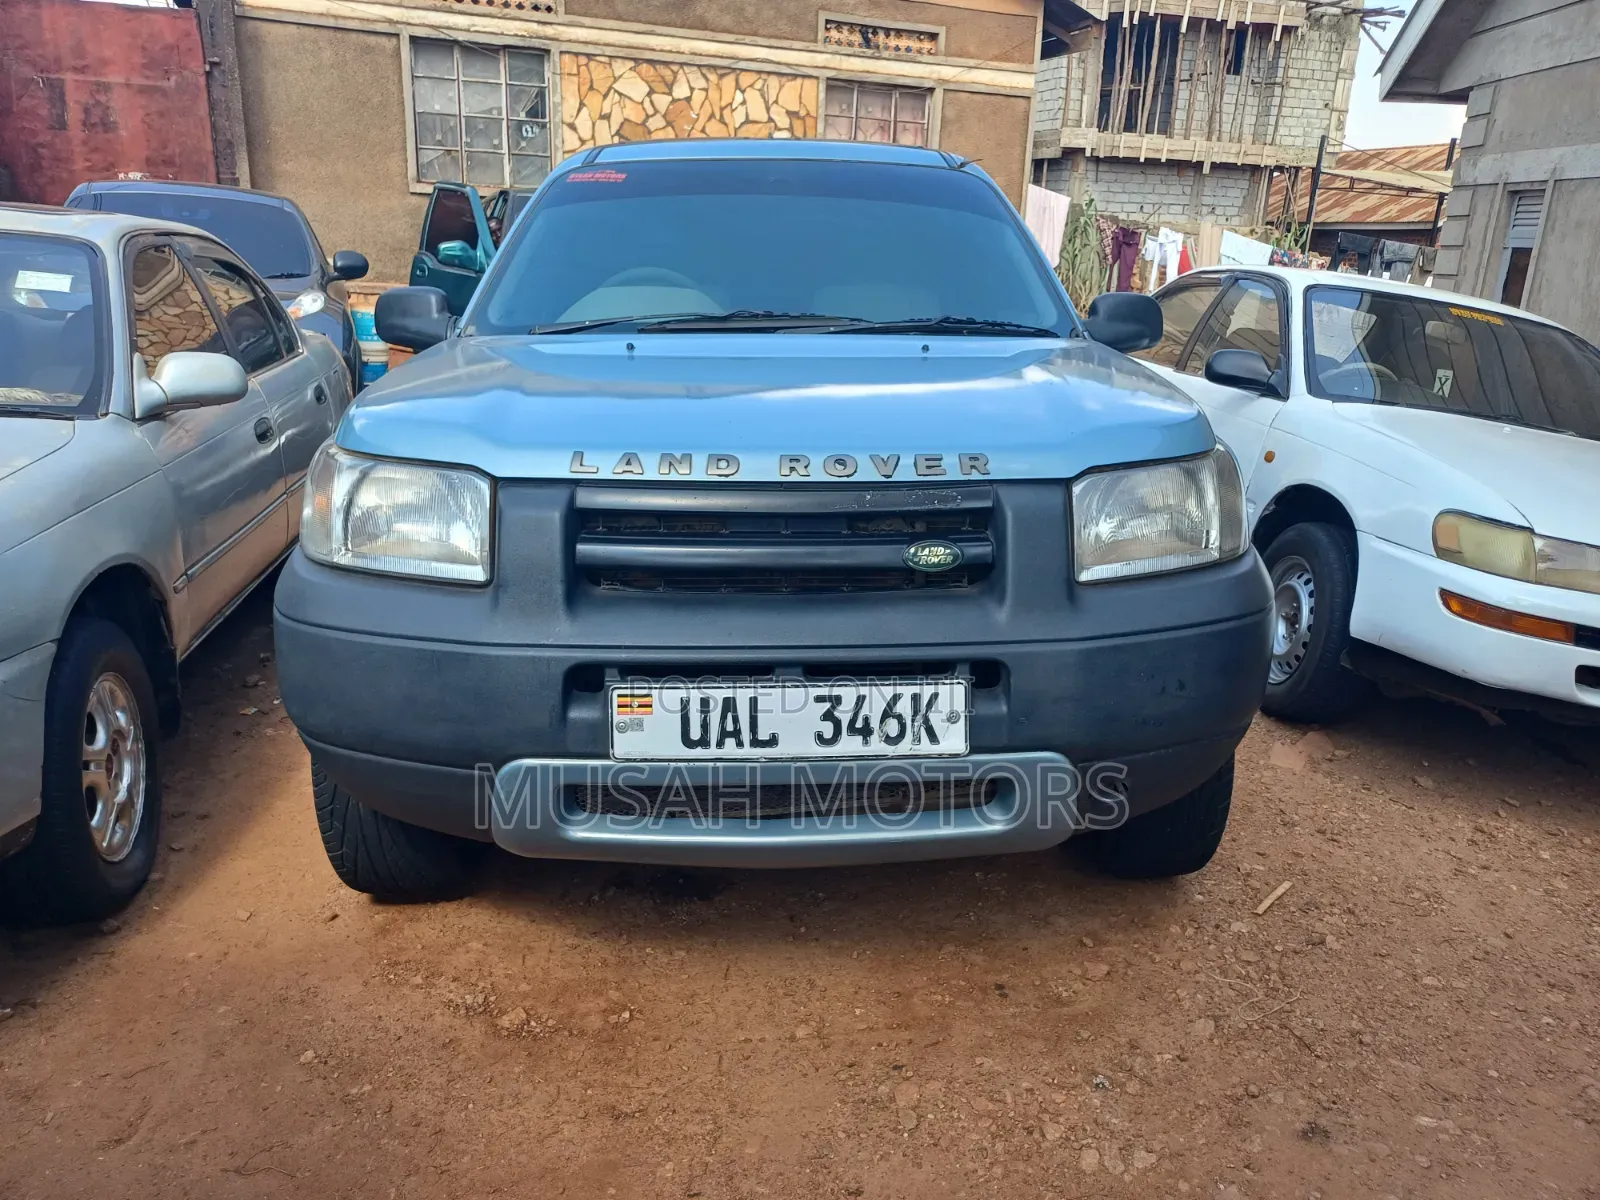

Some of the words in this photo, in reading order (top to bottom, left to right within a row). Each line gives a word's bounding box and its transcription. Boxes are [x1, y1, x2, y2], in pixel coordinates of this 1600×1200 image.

[570, 451, 740, 478] LAND
[779, 453, 991, 478] ROVER
[917, 547, 944, 556] LAND
[919, 556, 953, 564] ROVER
[680, 695, 779, 750] UAL
[812, 691, 941, 748] 346K
